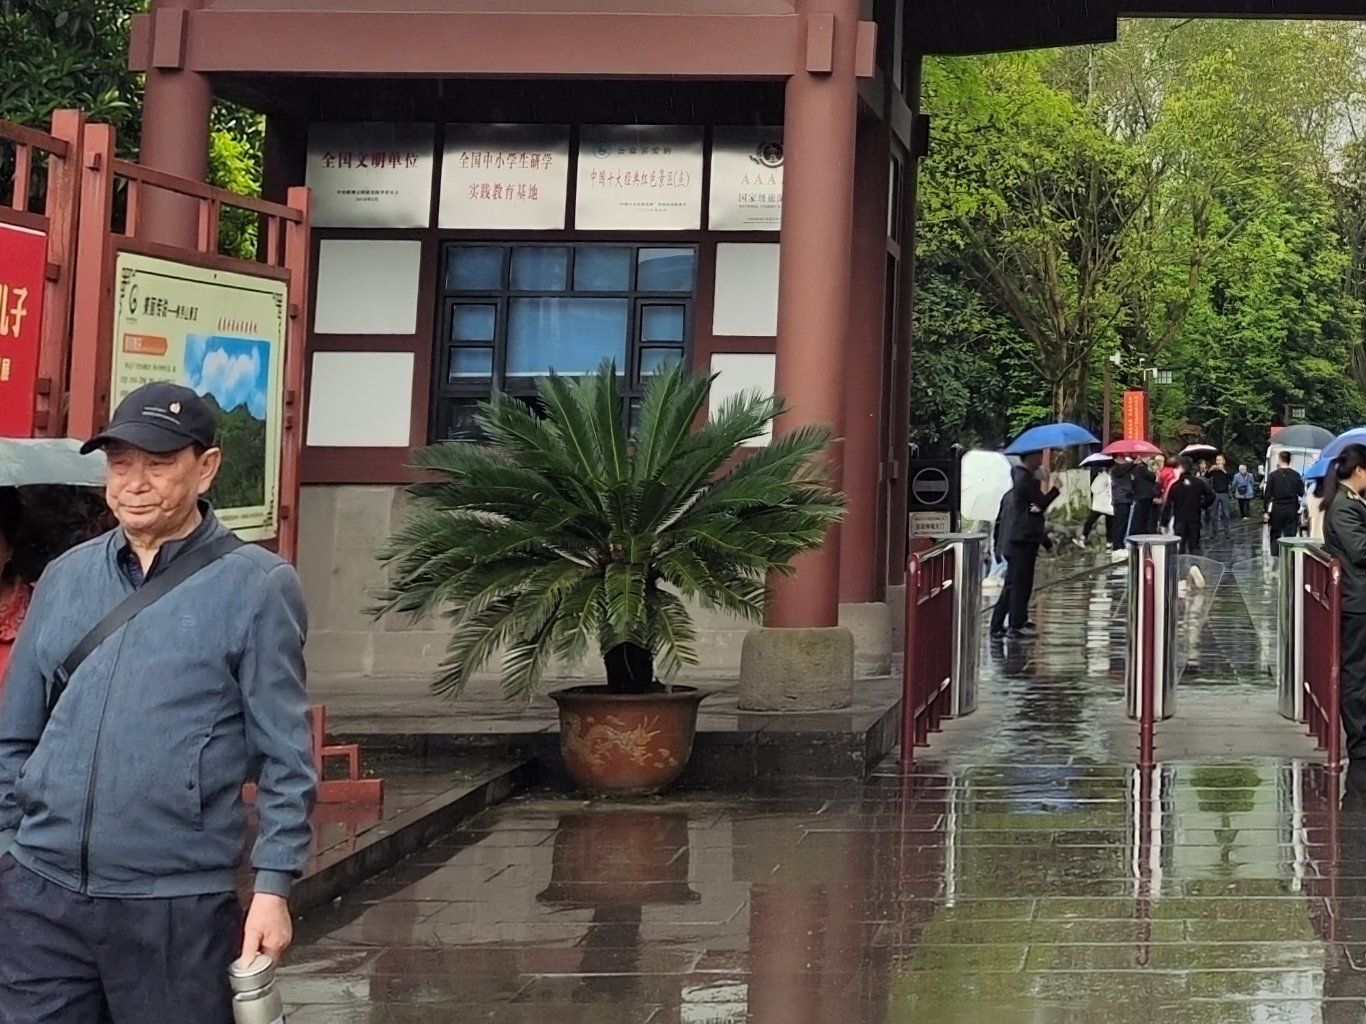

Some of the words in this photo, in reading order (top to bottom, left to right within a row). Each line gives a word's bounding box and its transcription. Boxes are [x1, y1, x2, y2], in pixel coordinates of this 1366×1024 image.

[320, 151, 421, 170] 全国文明单位
[458, 150, 554, 170] 全国中小学生研学
[467, 182, 540, 202] 实践教育基地
